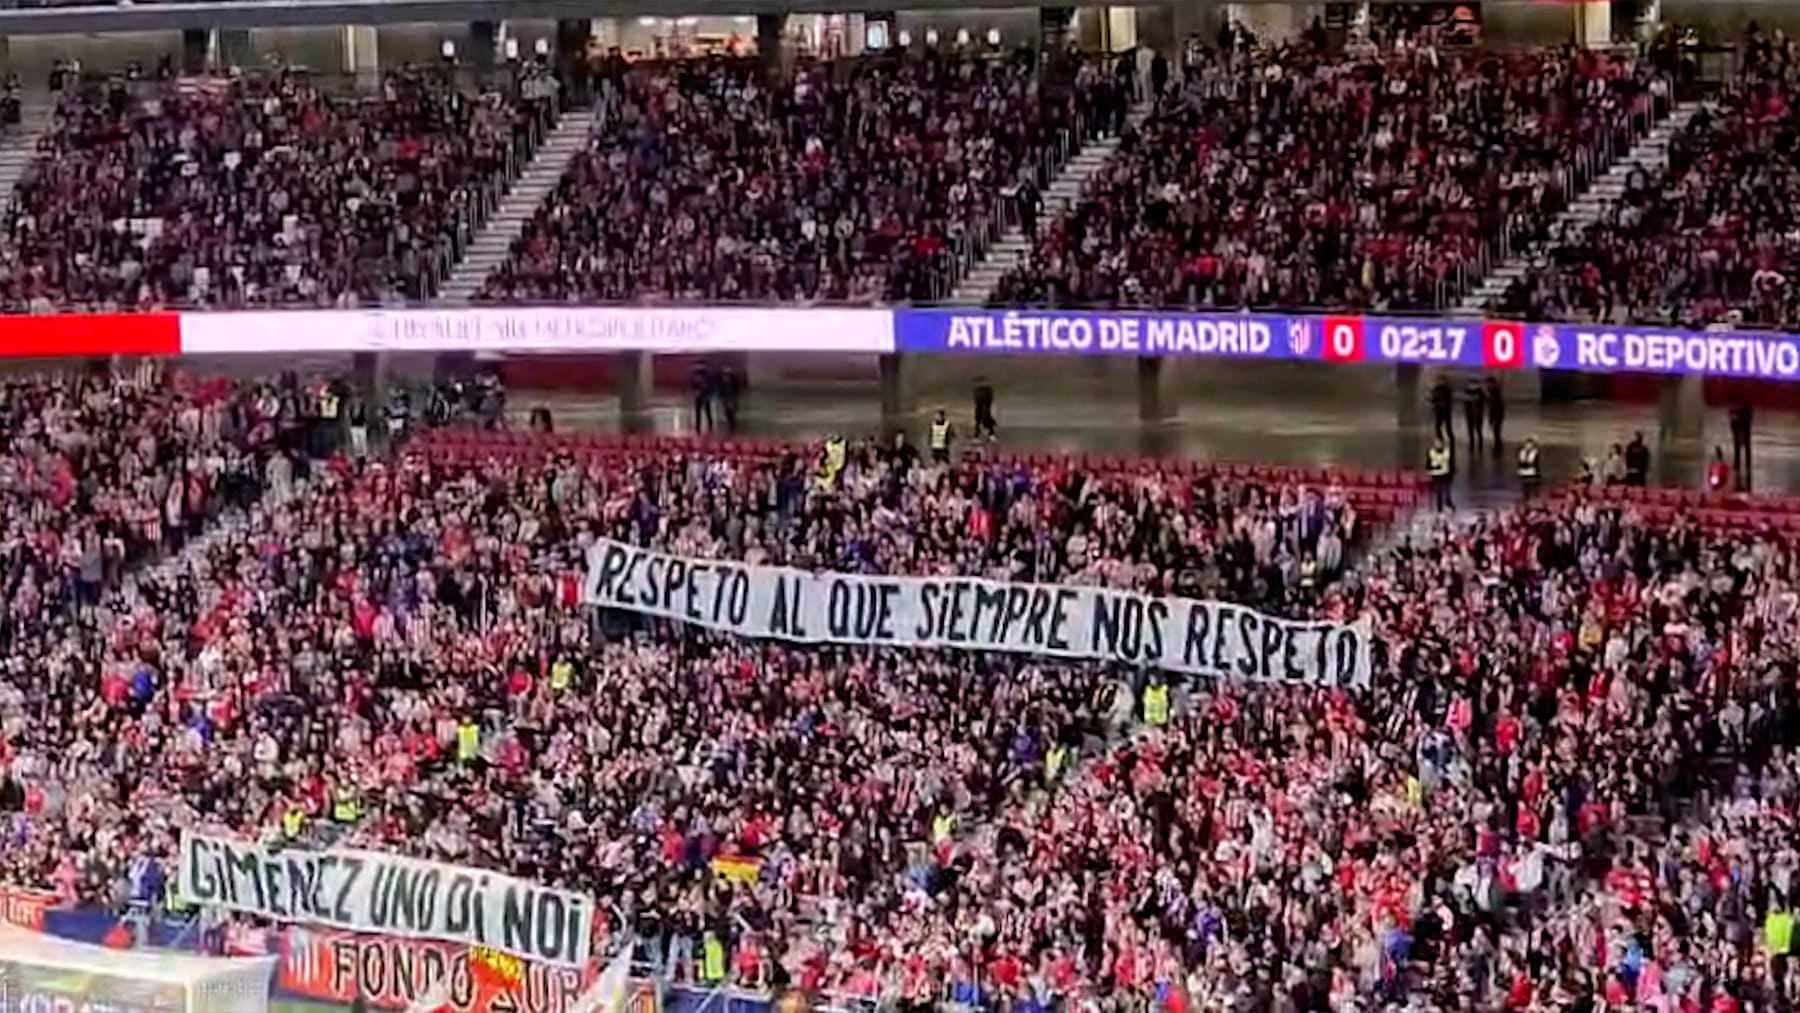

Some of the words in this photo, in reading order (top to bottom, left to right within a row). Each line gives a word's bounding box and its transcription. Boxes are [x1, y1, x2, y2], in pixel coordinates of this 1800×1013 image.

[947, 310, 1092, 348] ATLÉTICO
[1101, 323, 1138, 350] DE
[1146, 318, 1270, 353] MADRID
[1334, 326, 1353, 356] 0
[1380, 327, 1466, 359] 02:17
[1493, 330, 1514, 361] 0
[1578, 333, 1618, 366] RC
[1625, 334, 1799, 375] DEPORTIVO
[595, 544, 749, 626] RESPETO
[769, 576, 806, 638] AL
[828, 579, 900, 641] QUE
[1092, 594, 1170, 661] NOS
[1183, 603, 1358, 684] RESPETO
[371, 861, 442, 931] UNO
